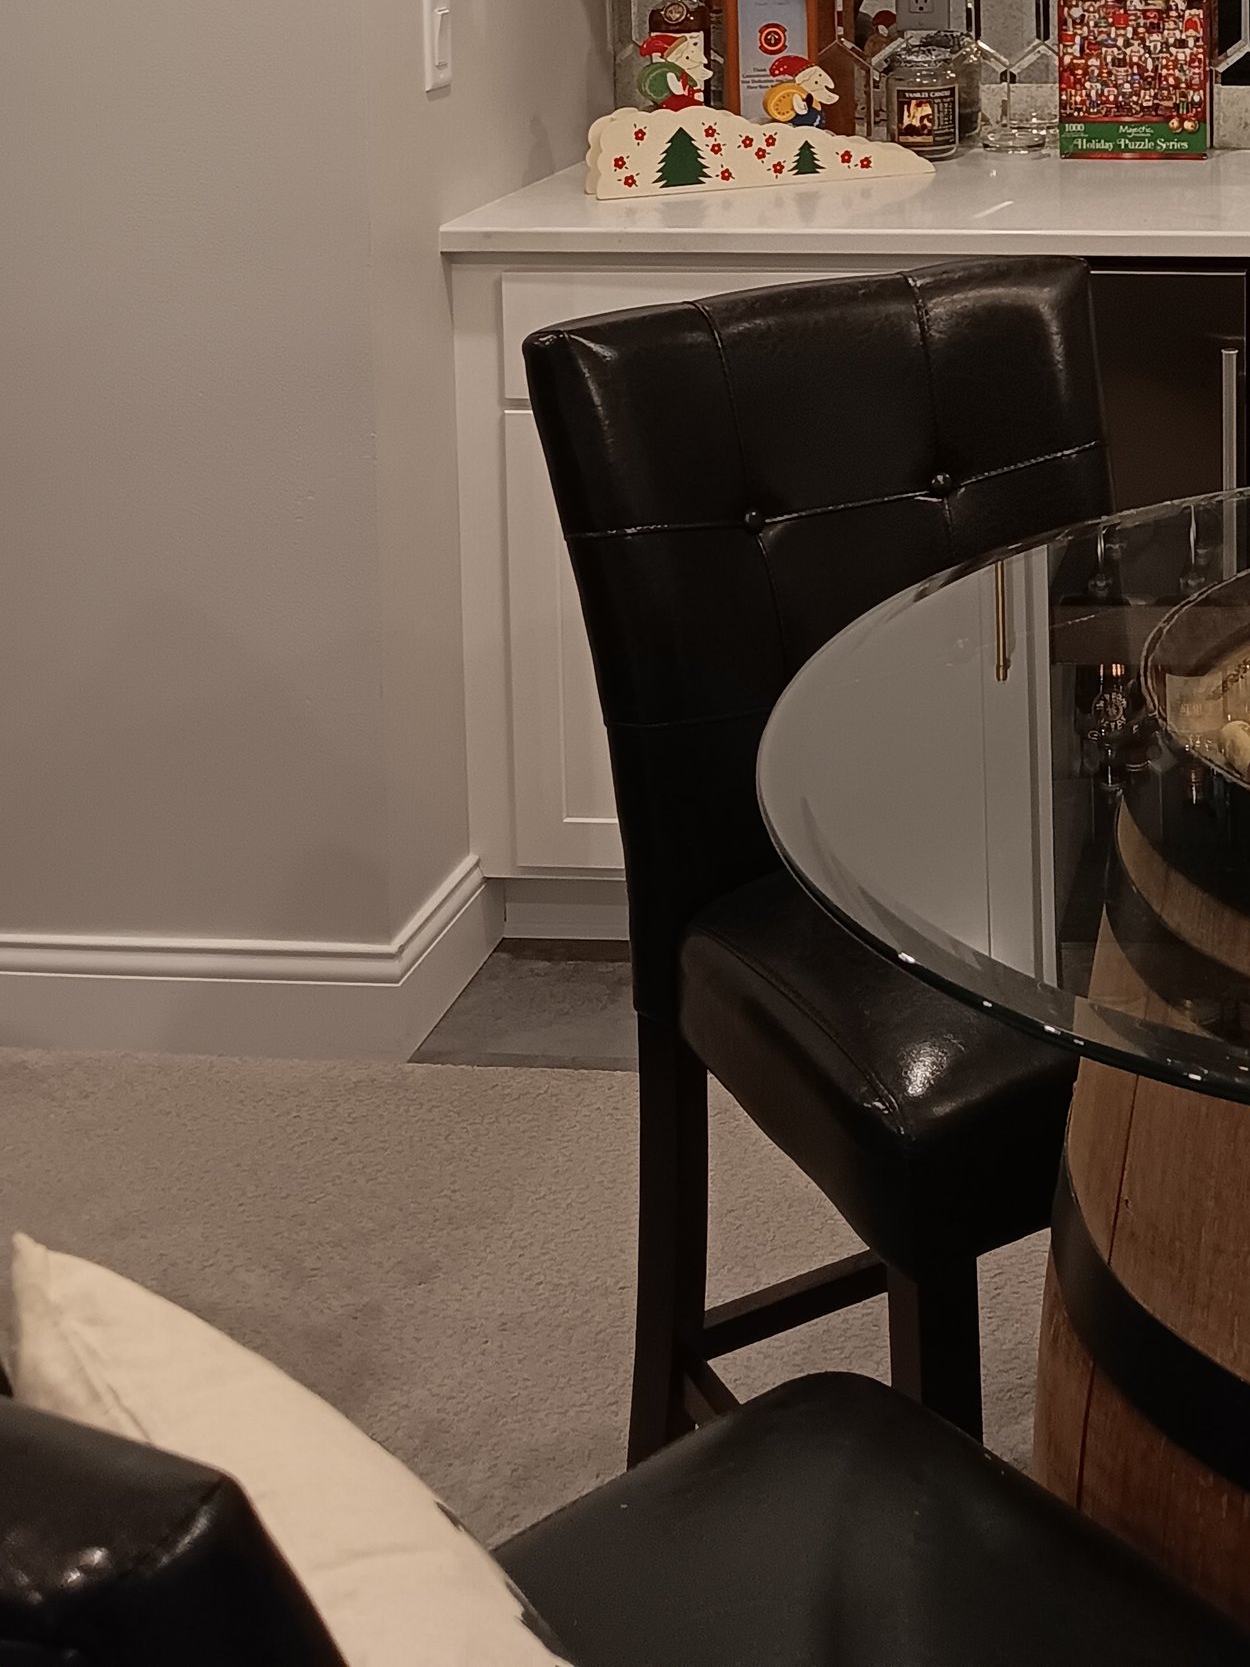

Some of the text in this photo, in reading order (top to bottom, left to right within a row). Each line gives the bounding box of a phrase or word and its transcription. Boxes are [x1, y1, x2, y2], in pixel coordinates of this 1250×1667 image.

[1064, 123, 1085, 132] 1000
[1118, 124, 1154, 138] Majestic
[1073, 138, 1188, 152] Holiday Puzzle Series
